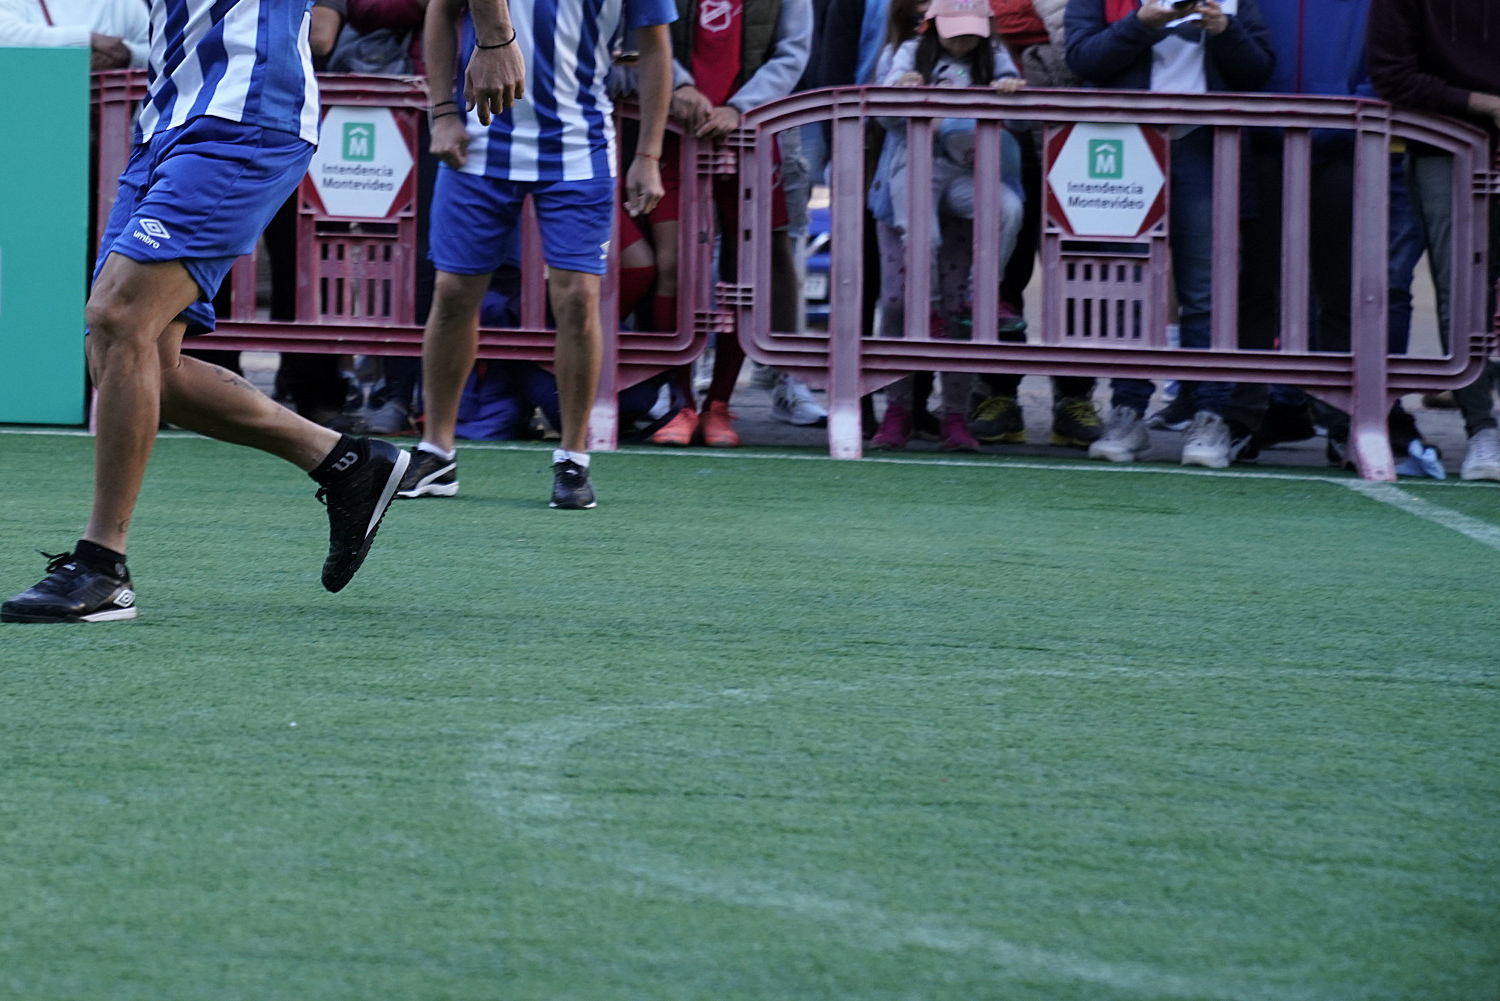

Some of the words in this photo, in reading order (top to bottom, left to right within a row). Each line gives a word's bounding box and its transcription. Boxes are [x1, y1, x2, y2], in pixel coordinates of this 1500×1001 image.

[321, 163, 394, 177] Intendencia
[321, 178, 394, 191] Montevideo
[1067, 182, 1144, 195] Intendencia
[1067, 196, 1145, 209] Montevideo
[133, 229, 161, 249] umbro
